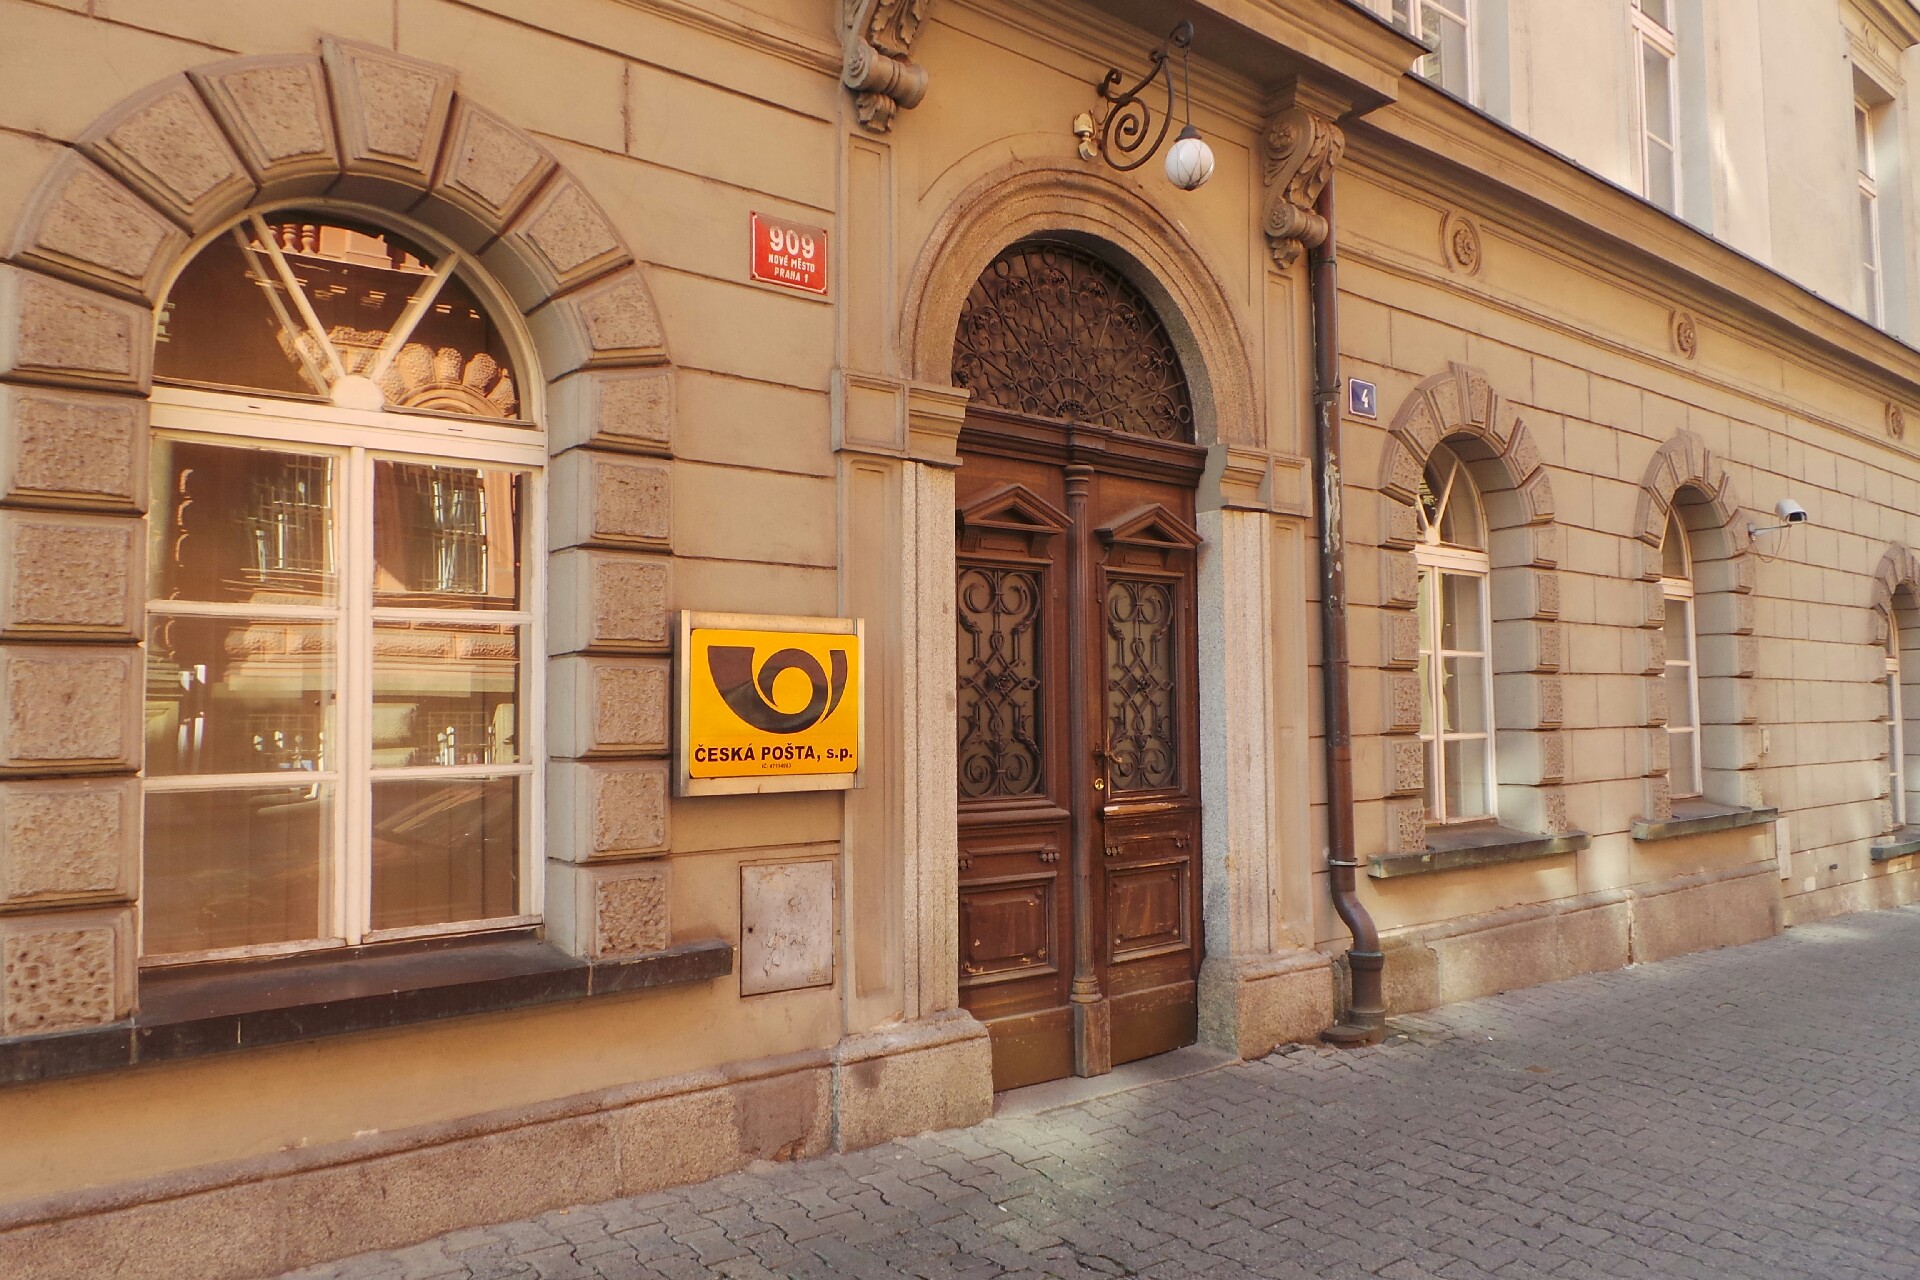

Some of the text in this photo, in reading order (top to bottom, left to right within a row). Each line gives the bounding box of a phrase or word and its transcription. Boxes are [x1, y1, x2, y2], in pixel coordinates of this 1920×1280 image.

[769, 226, 815, 259] 909
[768, 254, 815, 273] NOVÉ MĚSTO
[774, 267, 809, 283] PRAHA 1
[1361, 389, 1369, 408] 4
[694, 743, 853, 763] ČESKÁ POŠTA, s.p.
